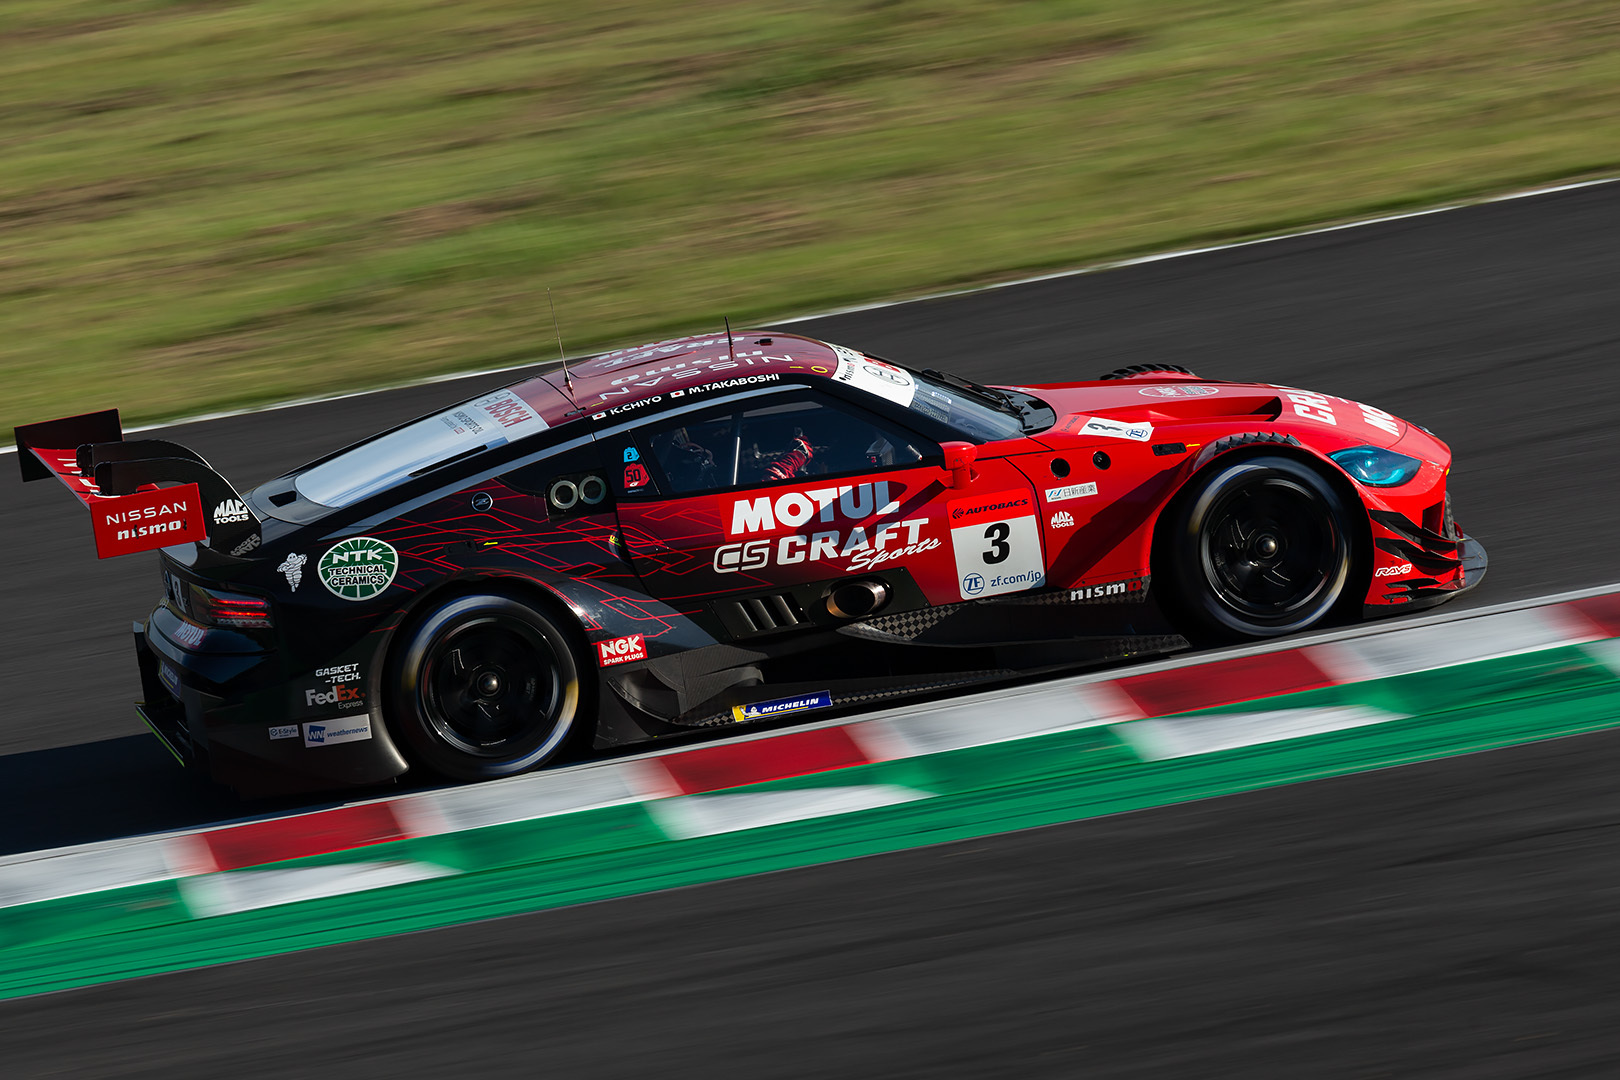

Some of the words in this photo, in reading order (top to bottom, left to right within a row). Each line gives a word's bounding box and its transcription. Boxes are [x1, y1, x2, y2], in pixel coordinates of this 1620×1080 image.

[599, 352, 794, 401] NISSAN
[610, 395, 662, 416] K.CHIYO
[688, 373, 780, 395] M.TAKABOSHI
[484, 398, 533, 428] BOSCH
[626, 451, 633, 460] 2
[625, 468, 641, 483] 50
[106, 501, 187, 526] NISSAN
[213, 499, 249, 519] MAC
[730, 480, 900, 535] MOTUL
[965, 498, 1028, 516] AUTOBACS
[213, 514, 249, 525] TOOLS
[1051, 511, 1074, 525] MAC
[1051, 521, 1075, 529] TOOLS
[776, 518, 929, 566] CRAFT
[982, 522, 1010, 565] 3
[332, 547, 383, 565] NTK
[846, 536, 942, 572] Sports
[328, 564, 387, 577] TECHNICAL
[1375, 563, 1412, 577] RAYS
[331, 575, 385, 586] CERAMICS
[963, 575, 985, 593] ZF
[990, 570, 1042, 587] zf.com/jp
[1070, 580, 1142, 602] nismo
[600, 635, 642, 658] NGK
[603, 656, 624, 665] SPARK
[624, 652, 644, 661] PLUGS
[315, 663, 359, 677] GASKET
[305, 685, 360, 706] FedEx
[337, 700, 364, 710] Express
[762, 698, 819, 713] MICHELIN
[327, 726, 369, 738] weathernews
